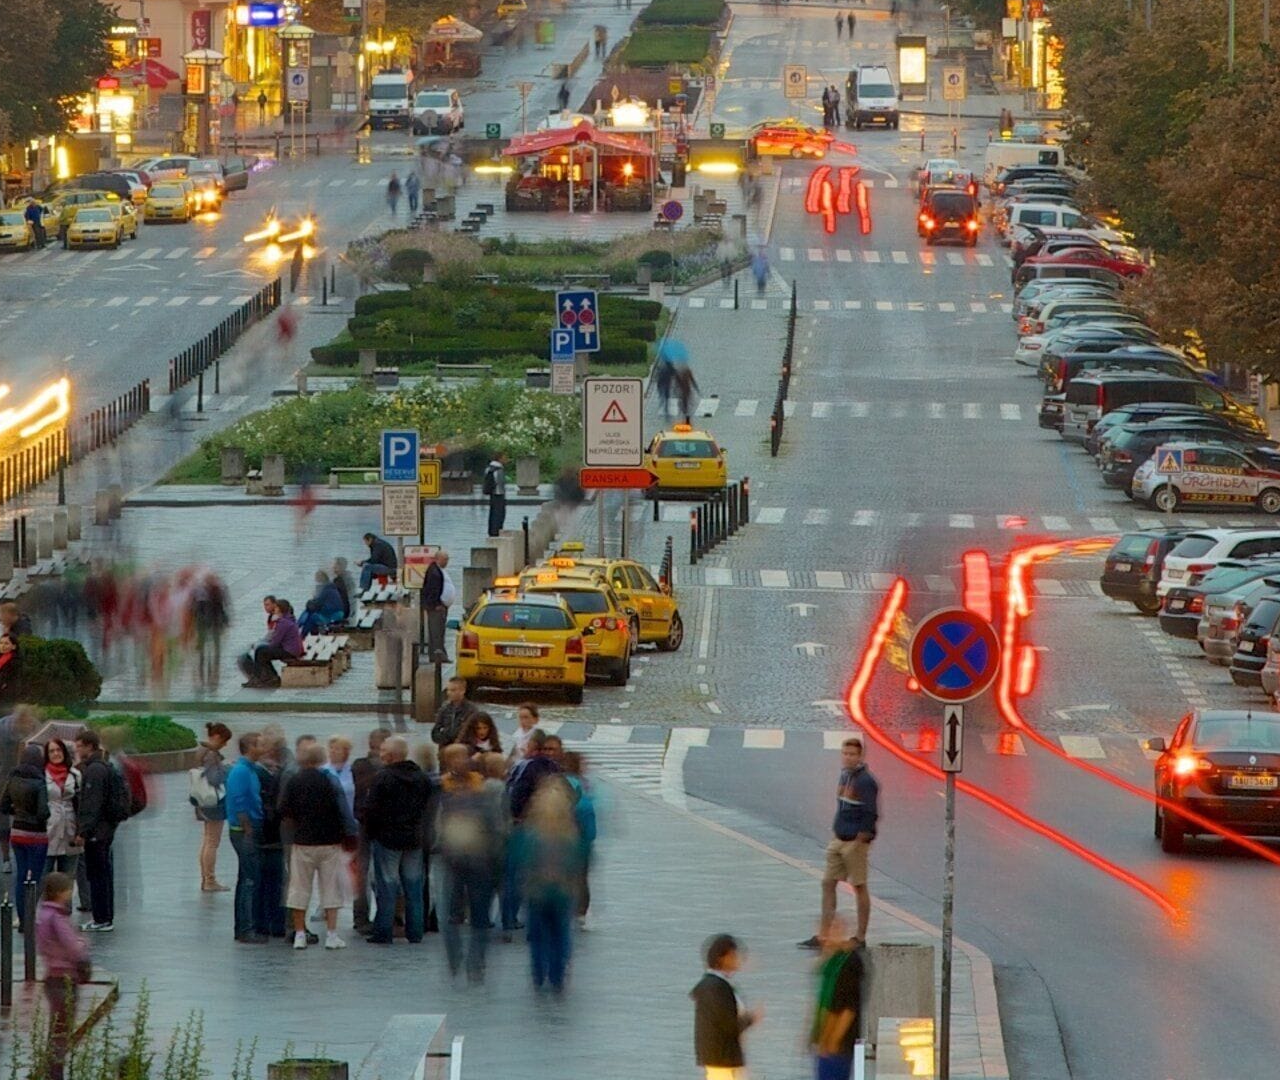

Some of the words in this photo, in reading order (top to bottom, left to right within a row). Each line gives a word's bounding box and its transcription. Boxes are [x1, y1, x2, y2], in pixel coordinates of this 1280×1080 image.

[556, 332, 570, 351] P
[594, 384, 634, 394] POZOR!
[389, 436, 412, 467] P
[1182, 474, 1248, 489] ORCHIDEA
